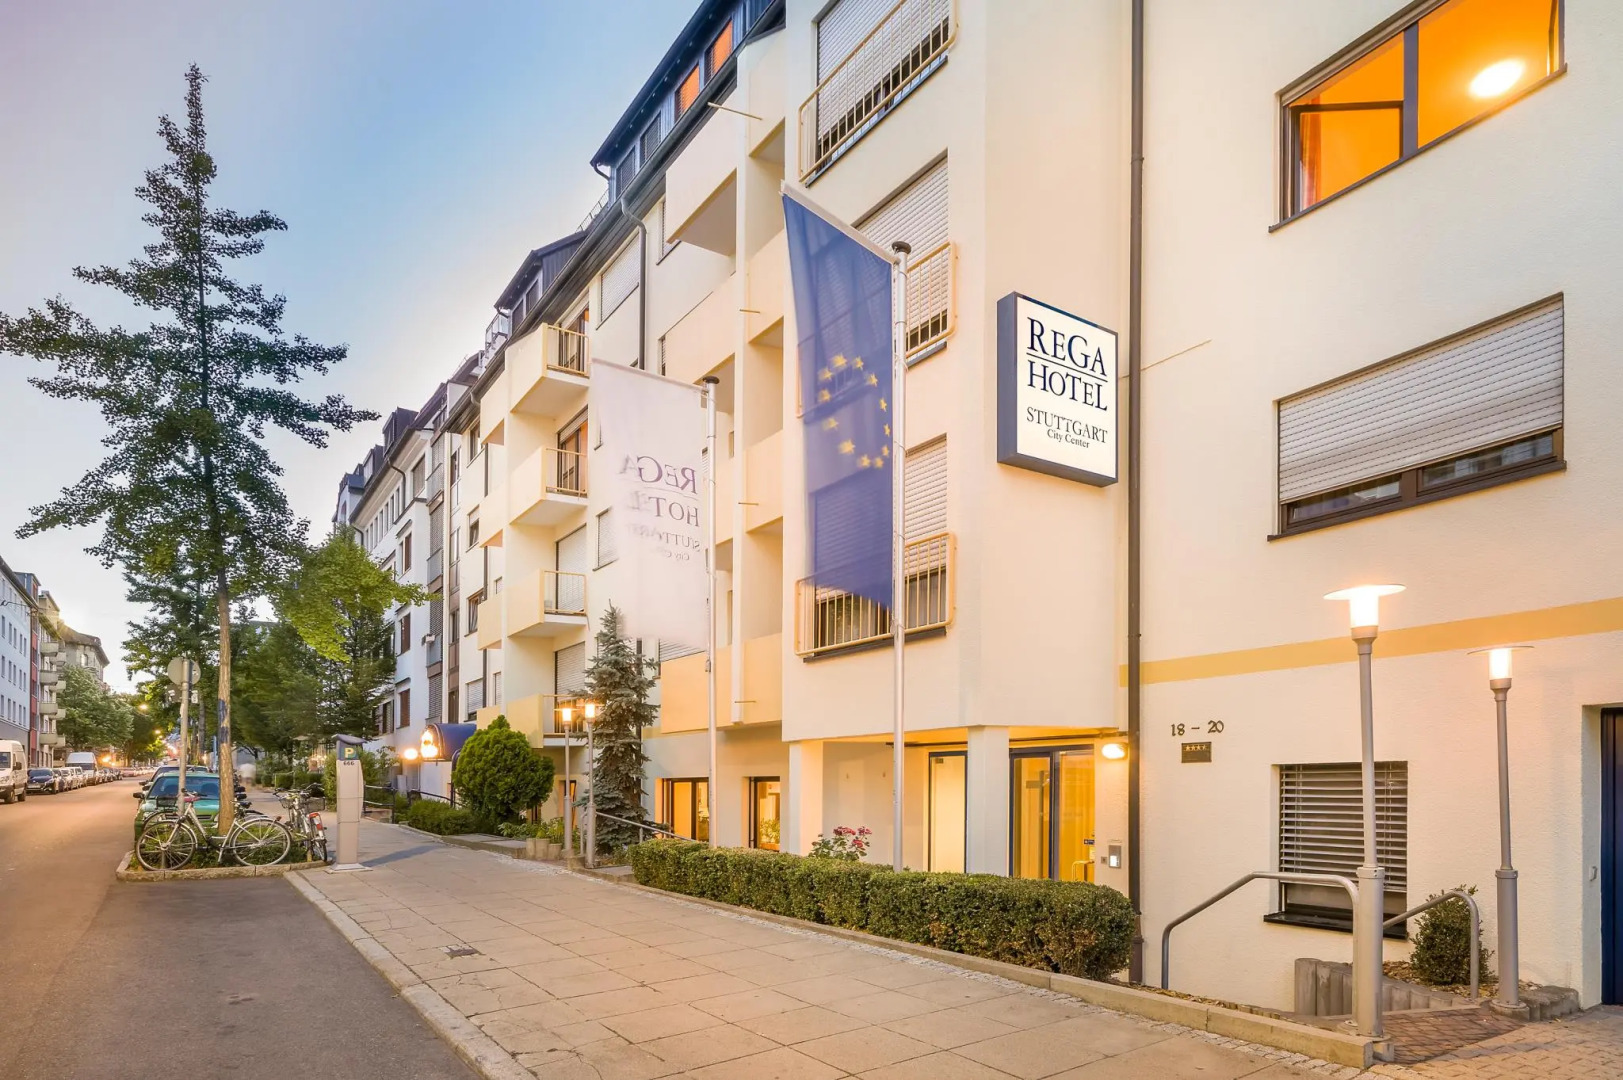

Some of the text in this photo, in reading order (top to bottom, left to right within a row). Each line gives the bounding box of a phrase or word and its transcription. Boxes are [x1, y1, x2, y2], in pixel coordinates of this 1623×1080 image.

[1027, 317, 1107, 377] REGA
[1027, 359, 1108, 411] HOTEL
[1027, 406, 1108, 443] STUTTGART
[1047, 428, 1090, 448] City Center
[1171, 723, 1185, 736] 18
[1208, 720, 1224, 733] 20
[344, 747, 355, 758] P
